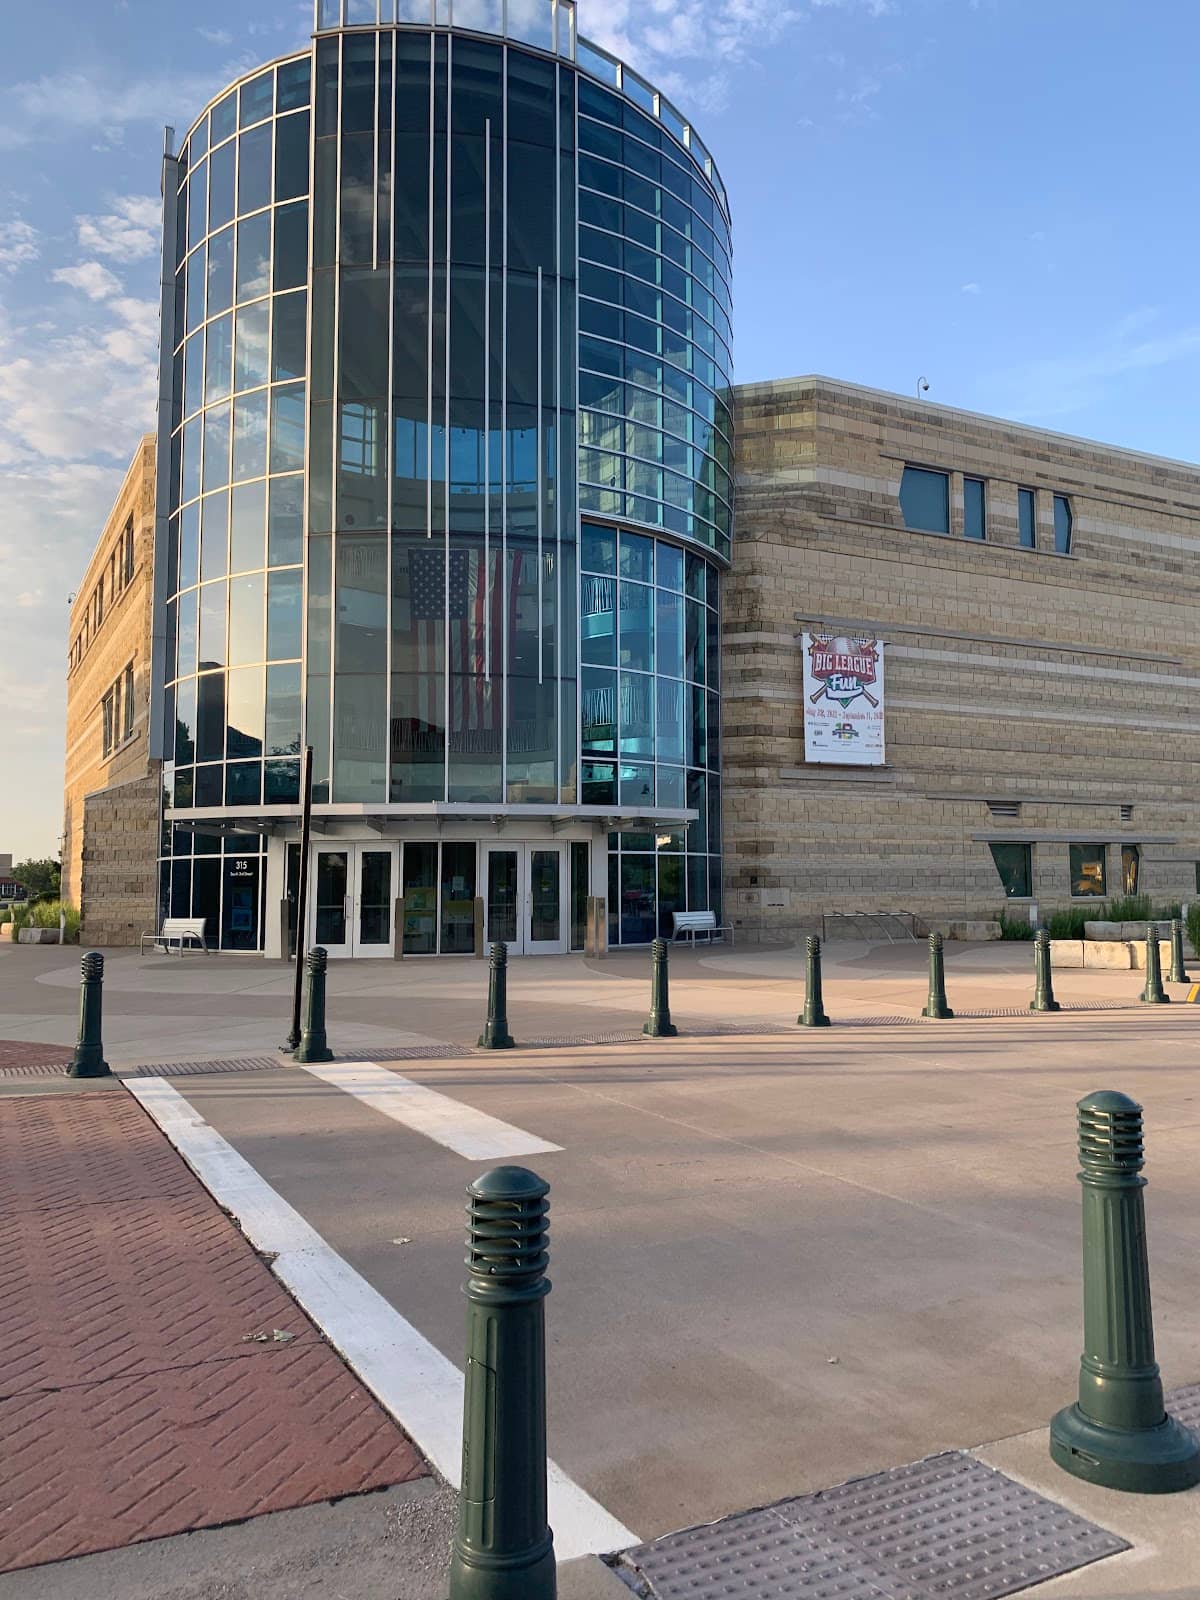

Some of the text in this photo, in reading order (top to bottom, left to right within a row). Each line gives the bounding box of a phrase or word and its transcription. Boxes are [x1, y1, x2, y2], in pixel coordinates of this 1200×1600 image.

[815, 653, 873, 676] BIG LEAGUE
[830, 673, 858, 692] Fun
[235, 860, 248, 870] 315
